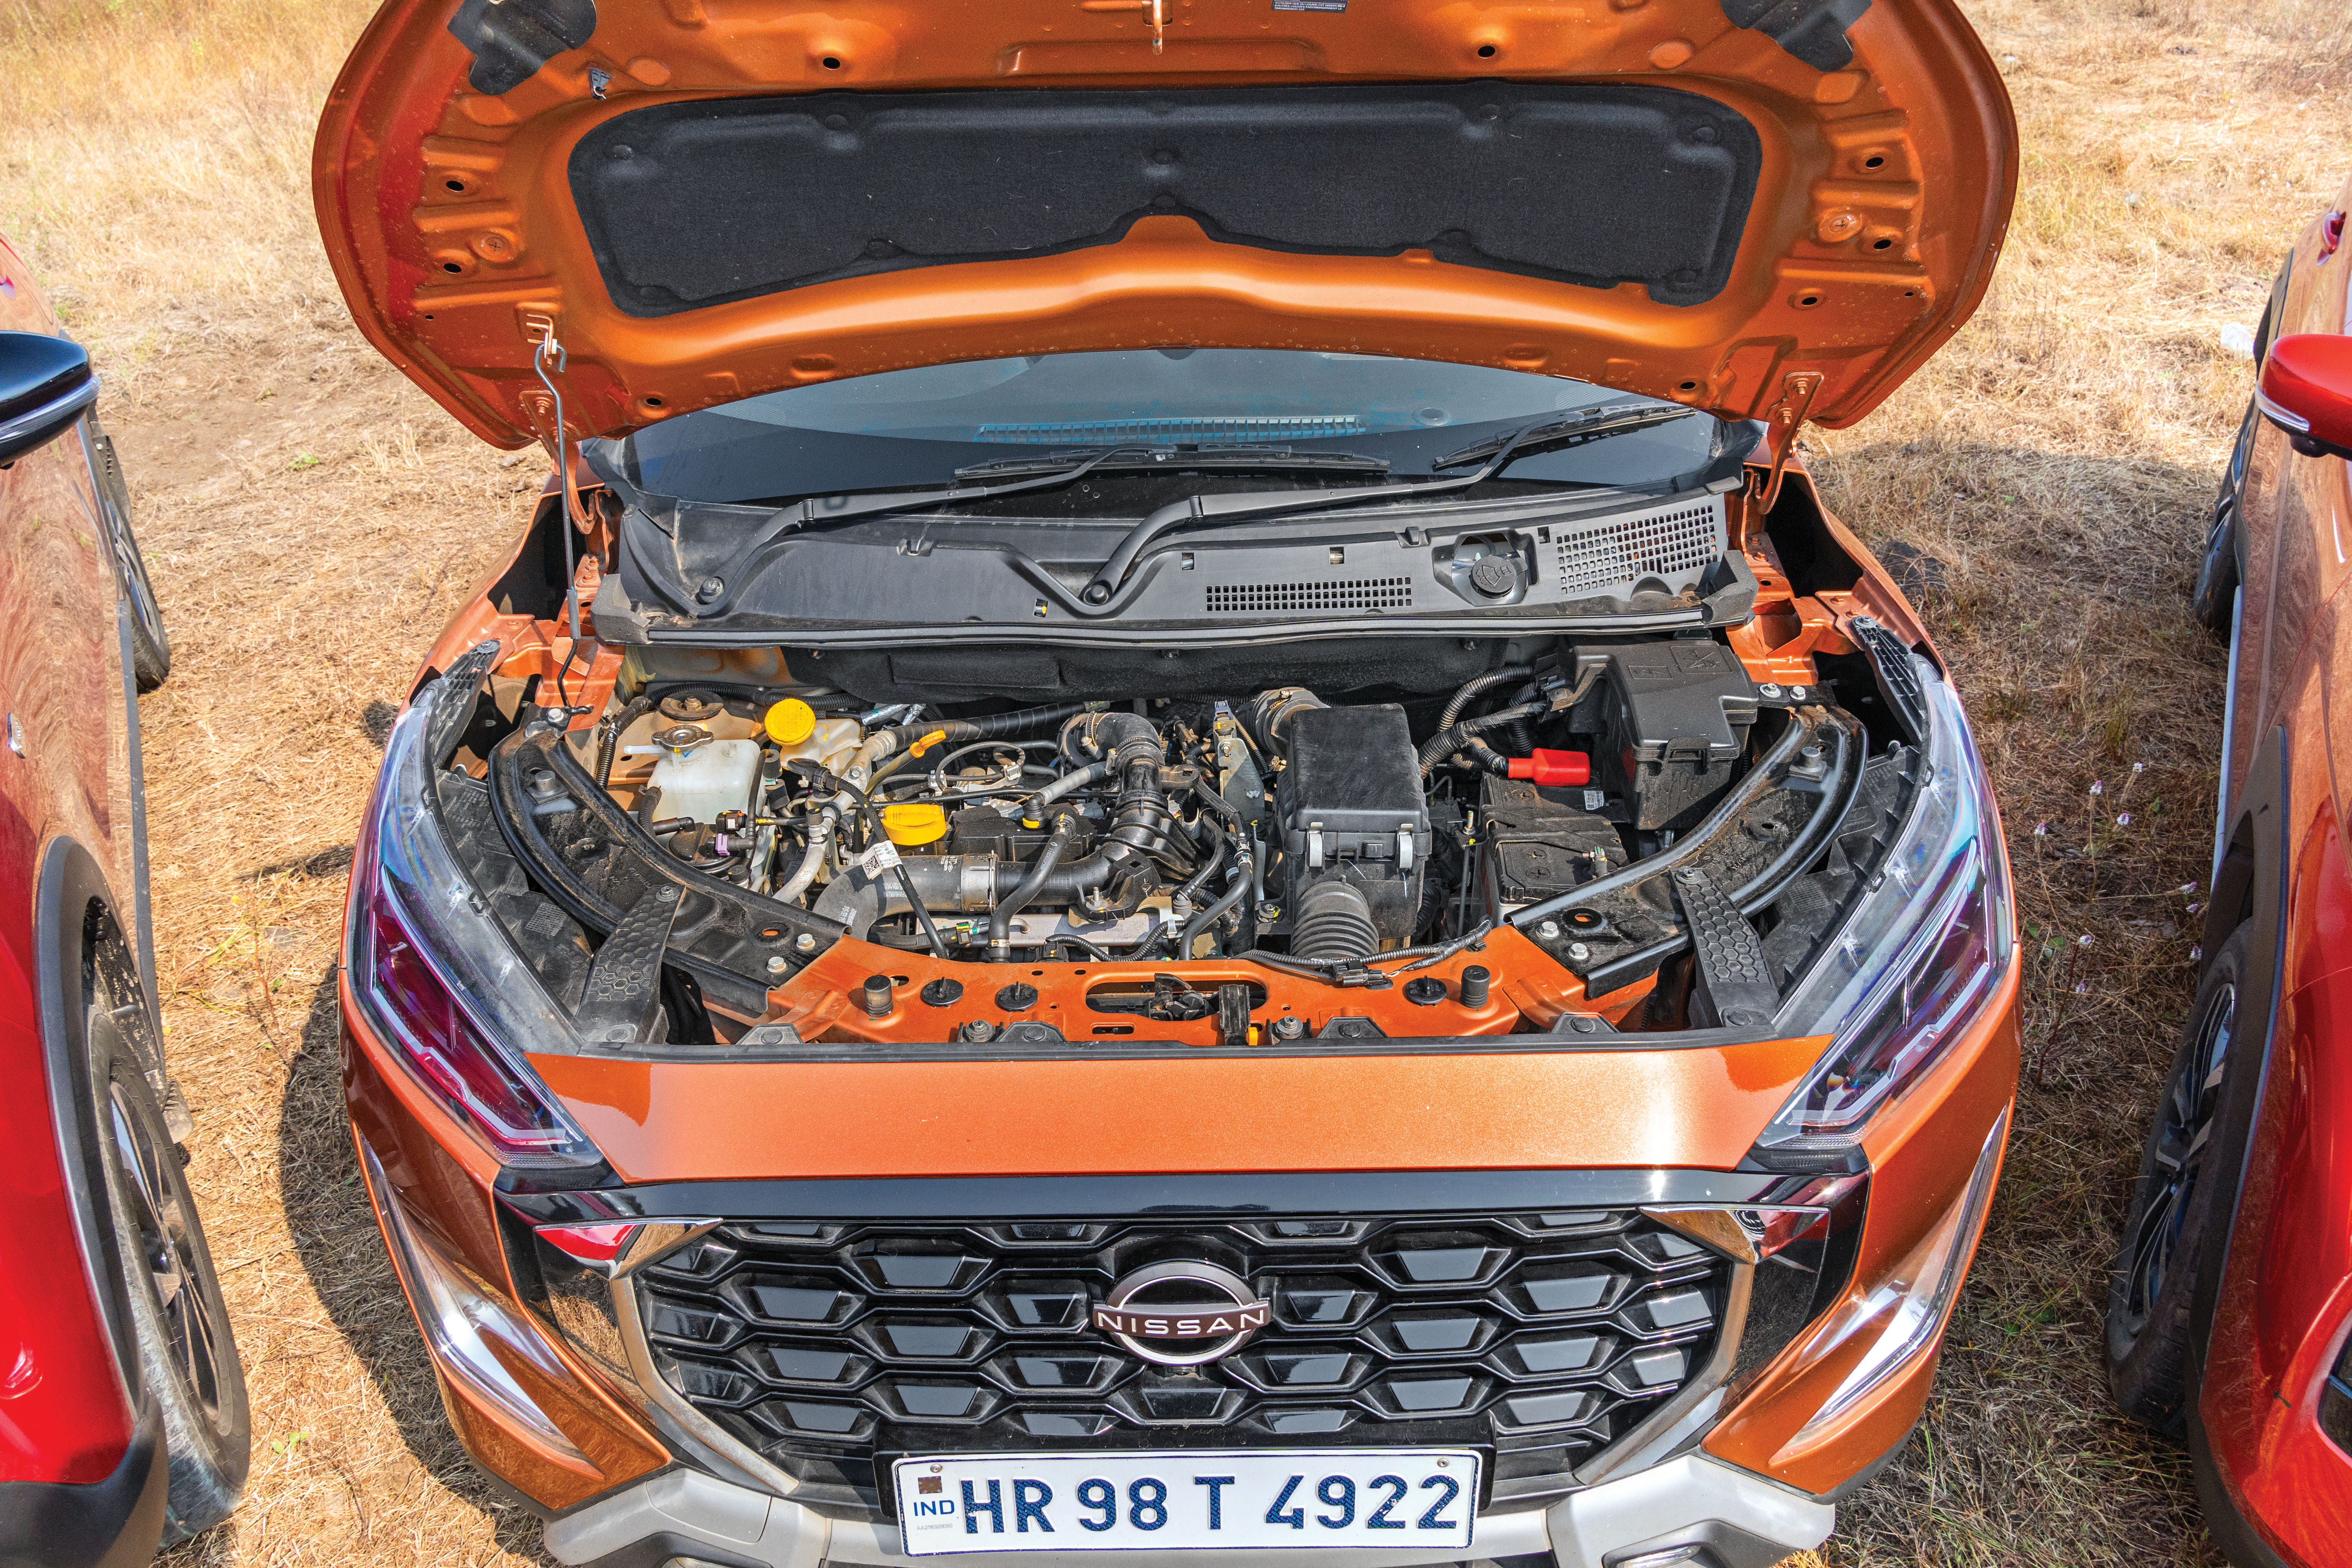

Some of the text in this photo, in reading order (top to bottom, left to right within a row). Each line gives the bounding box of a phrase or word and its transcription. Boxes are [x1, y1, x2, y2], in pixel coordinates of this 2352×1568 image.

[1098, 1309, 1265, 1335] NISSAN
[914, 1500, 955, 1516] IND
[960, 1473, 1459, 1534] HR 98 T 4922
